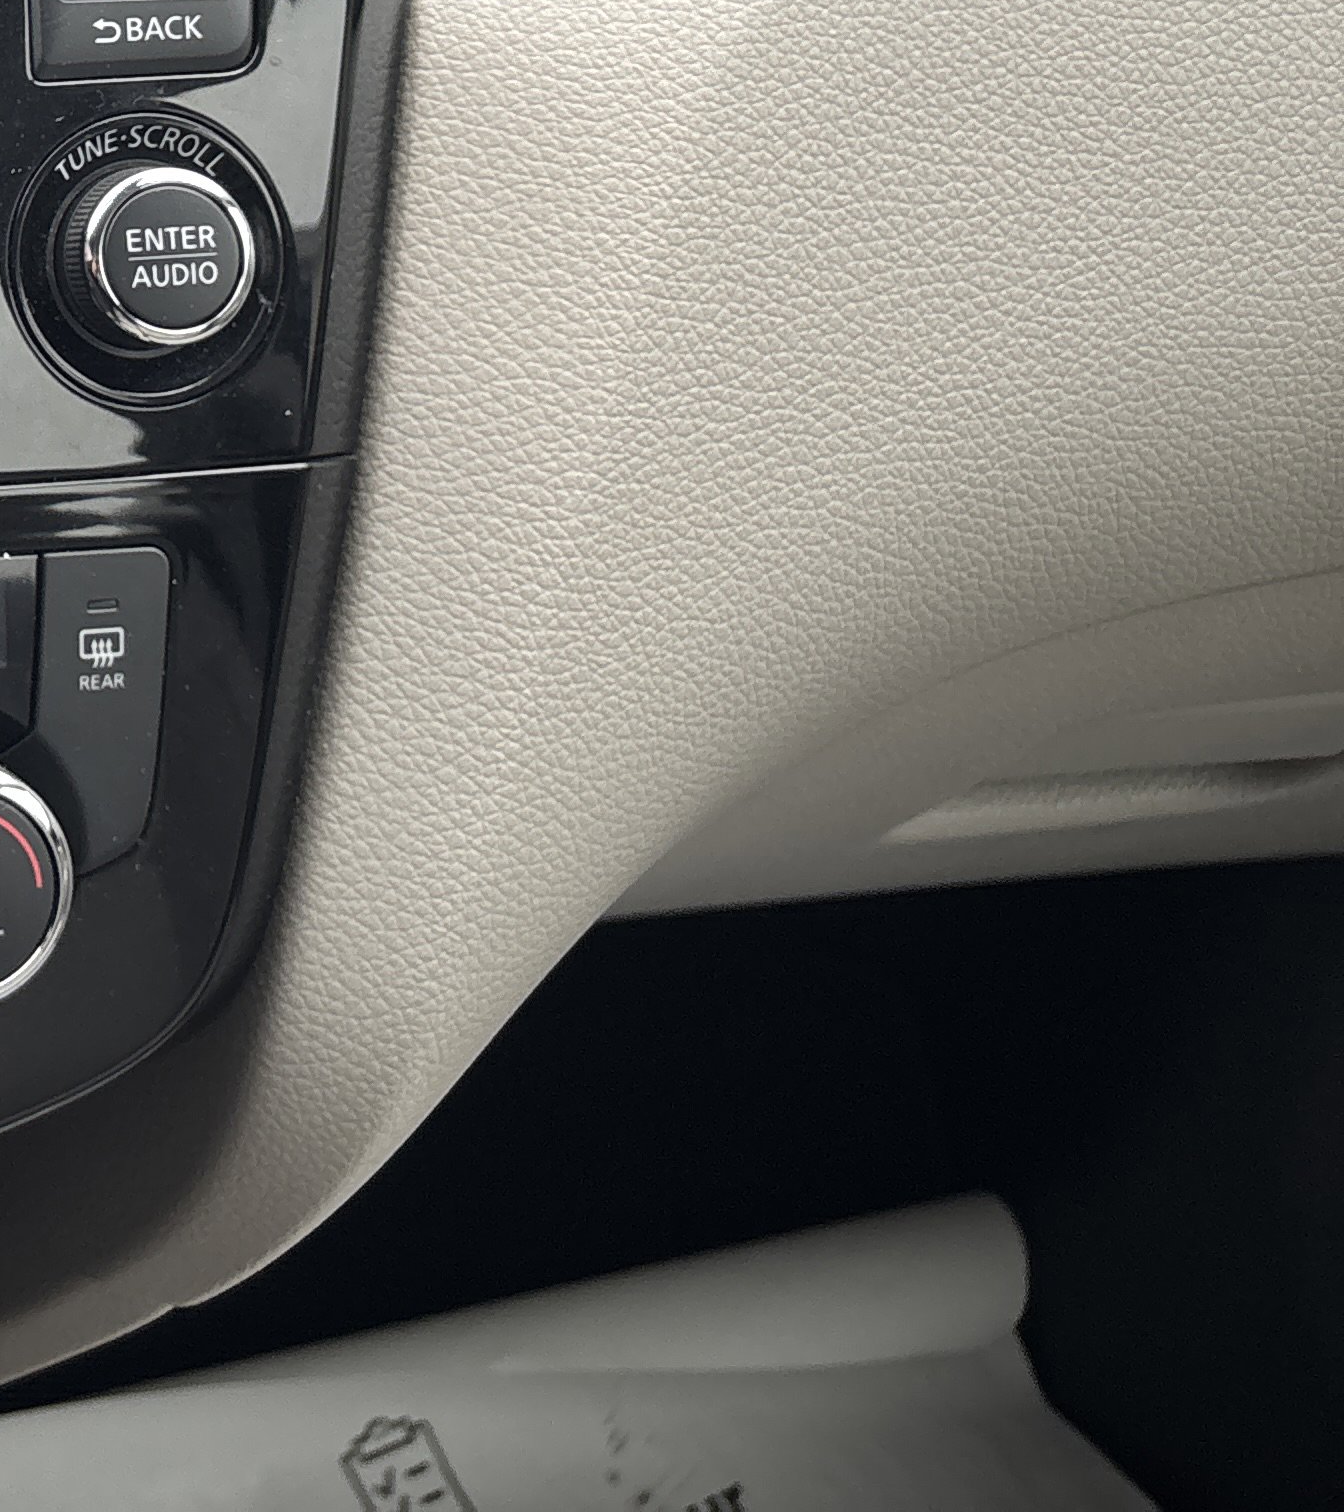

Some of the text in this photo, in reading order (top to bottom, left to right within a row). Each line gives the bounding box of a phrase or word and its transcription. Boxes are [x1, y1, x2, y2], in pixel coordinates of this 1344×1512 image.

[125, 15, 203, 41] BACK
[126, 225, 216, 254] ENTER
[131, 260, 219, 288] AUDIO
[79, 672, 126, 690] REAR
